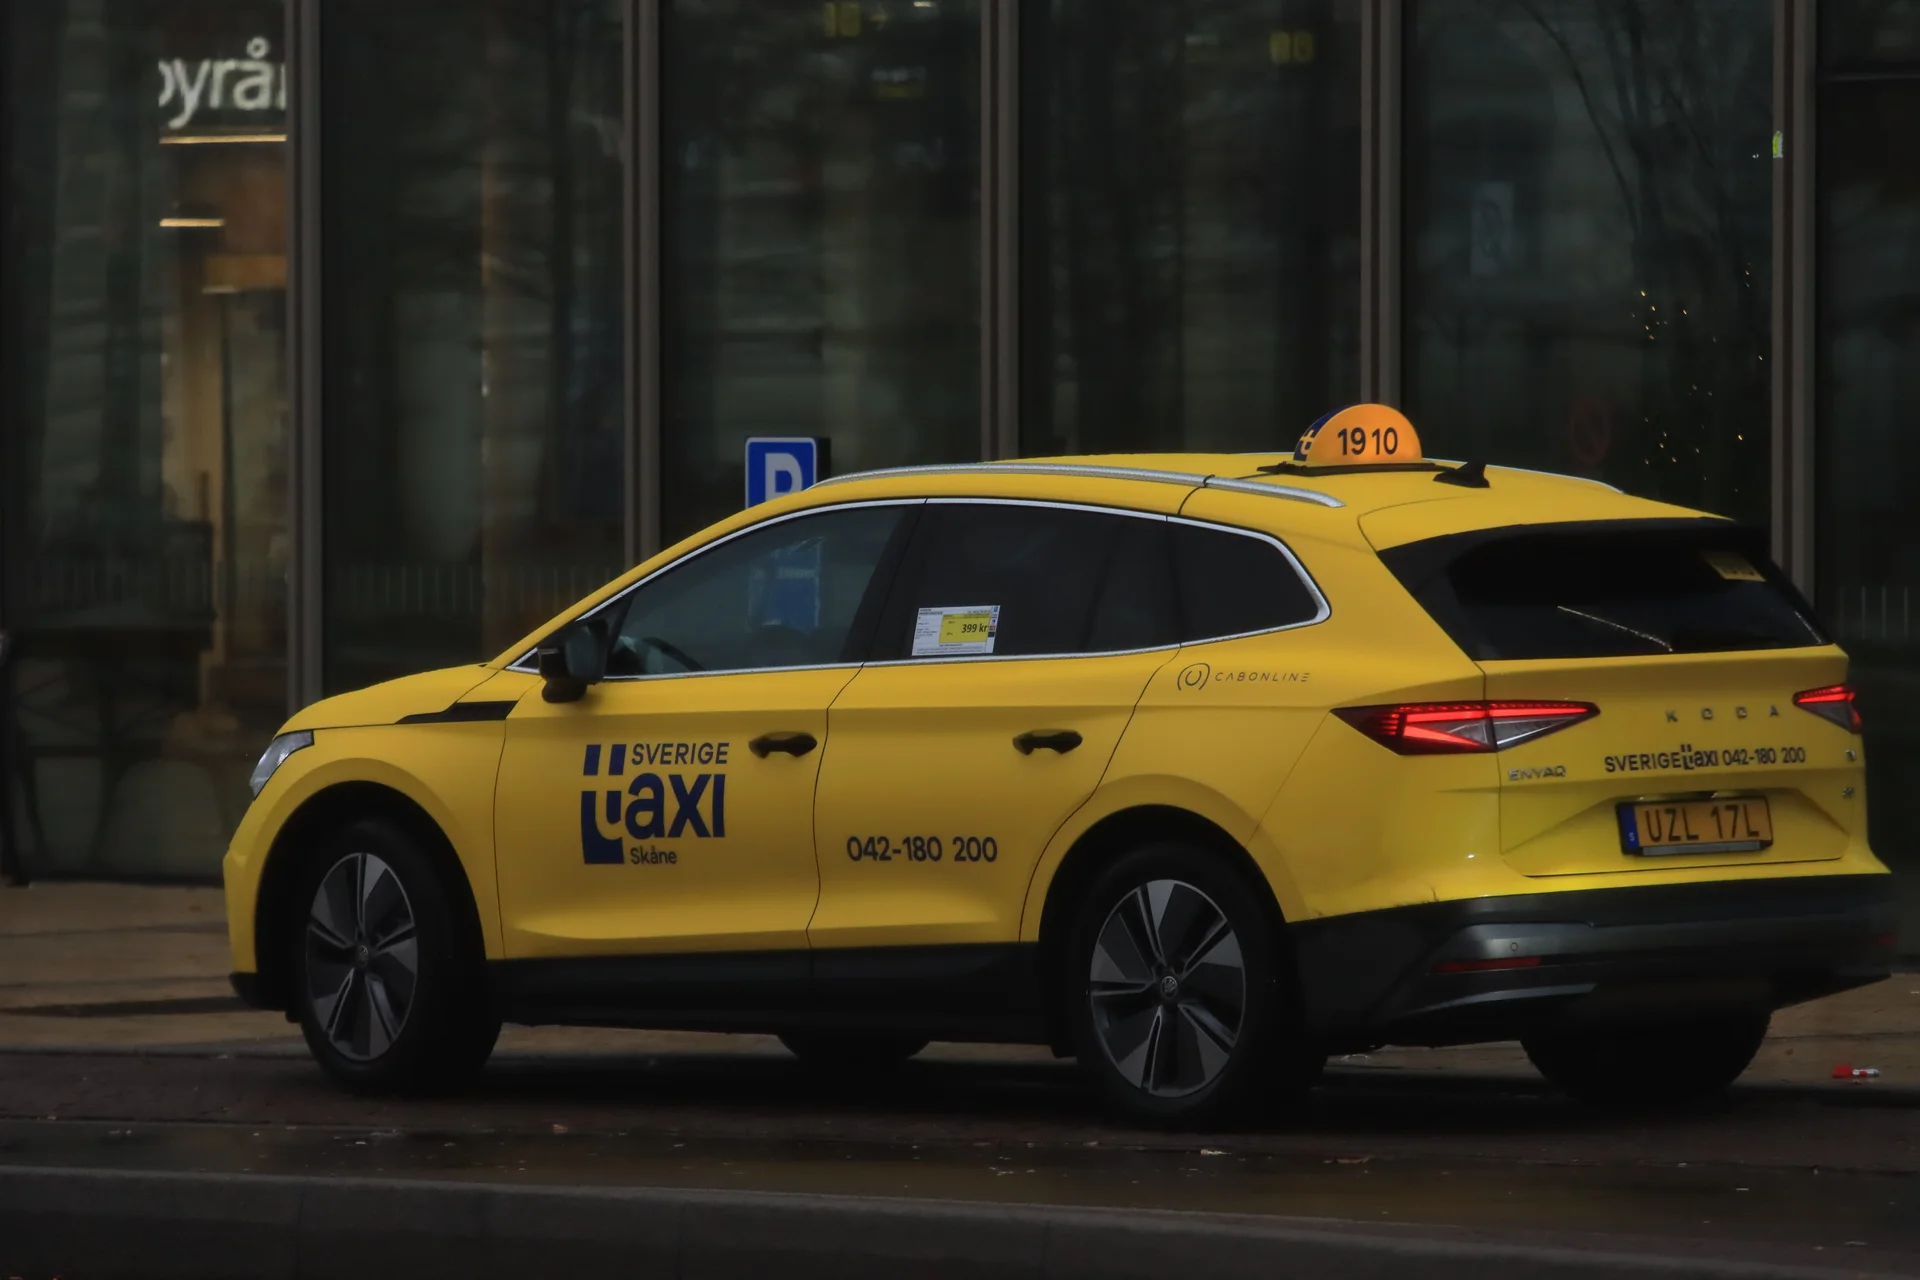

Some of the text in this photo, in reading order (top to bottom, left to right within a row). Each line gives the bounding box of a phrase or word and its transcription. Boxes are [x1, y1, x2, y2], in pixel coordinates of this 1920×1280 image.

[1338, 427, 1399, 456] 1910
[765, 453, 803, 502] P
[961, 623, 988, 633] 399 kr
[1214, 672, 1311, 682] CABONLINE
[631, 743, 730, 766] SVERIGE
[1722, 748, 1777, 766] 042-180
[1782, 746, 1806, 764] 200
[1508, 765, 1567, 781] ENYAQ
[1645, 807, 1699, 842] UZL
[1710, 804, 1760, 839] 17L
[630, 845, 678, 865] Skåne
[846, 836, 998, 863] 042-180 200
